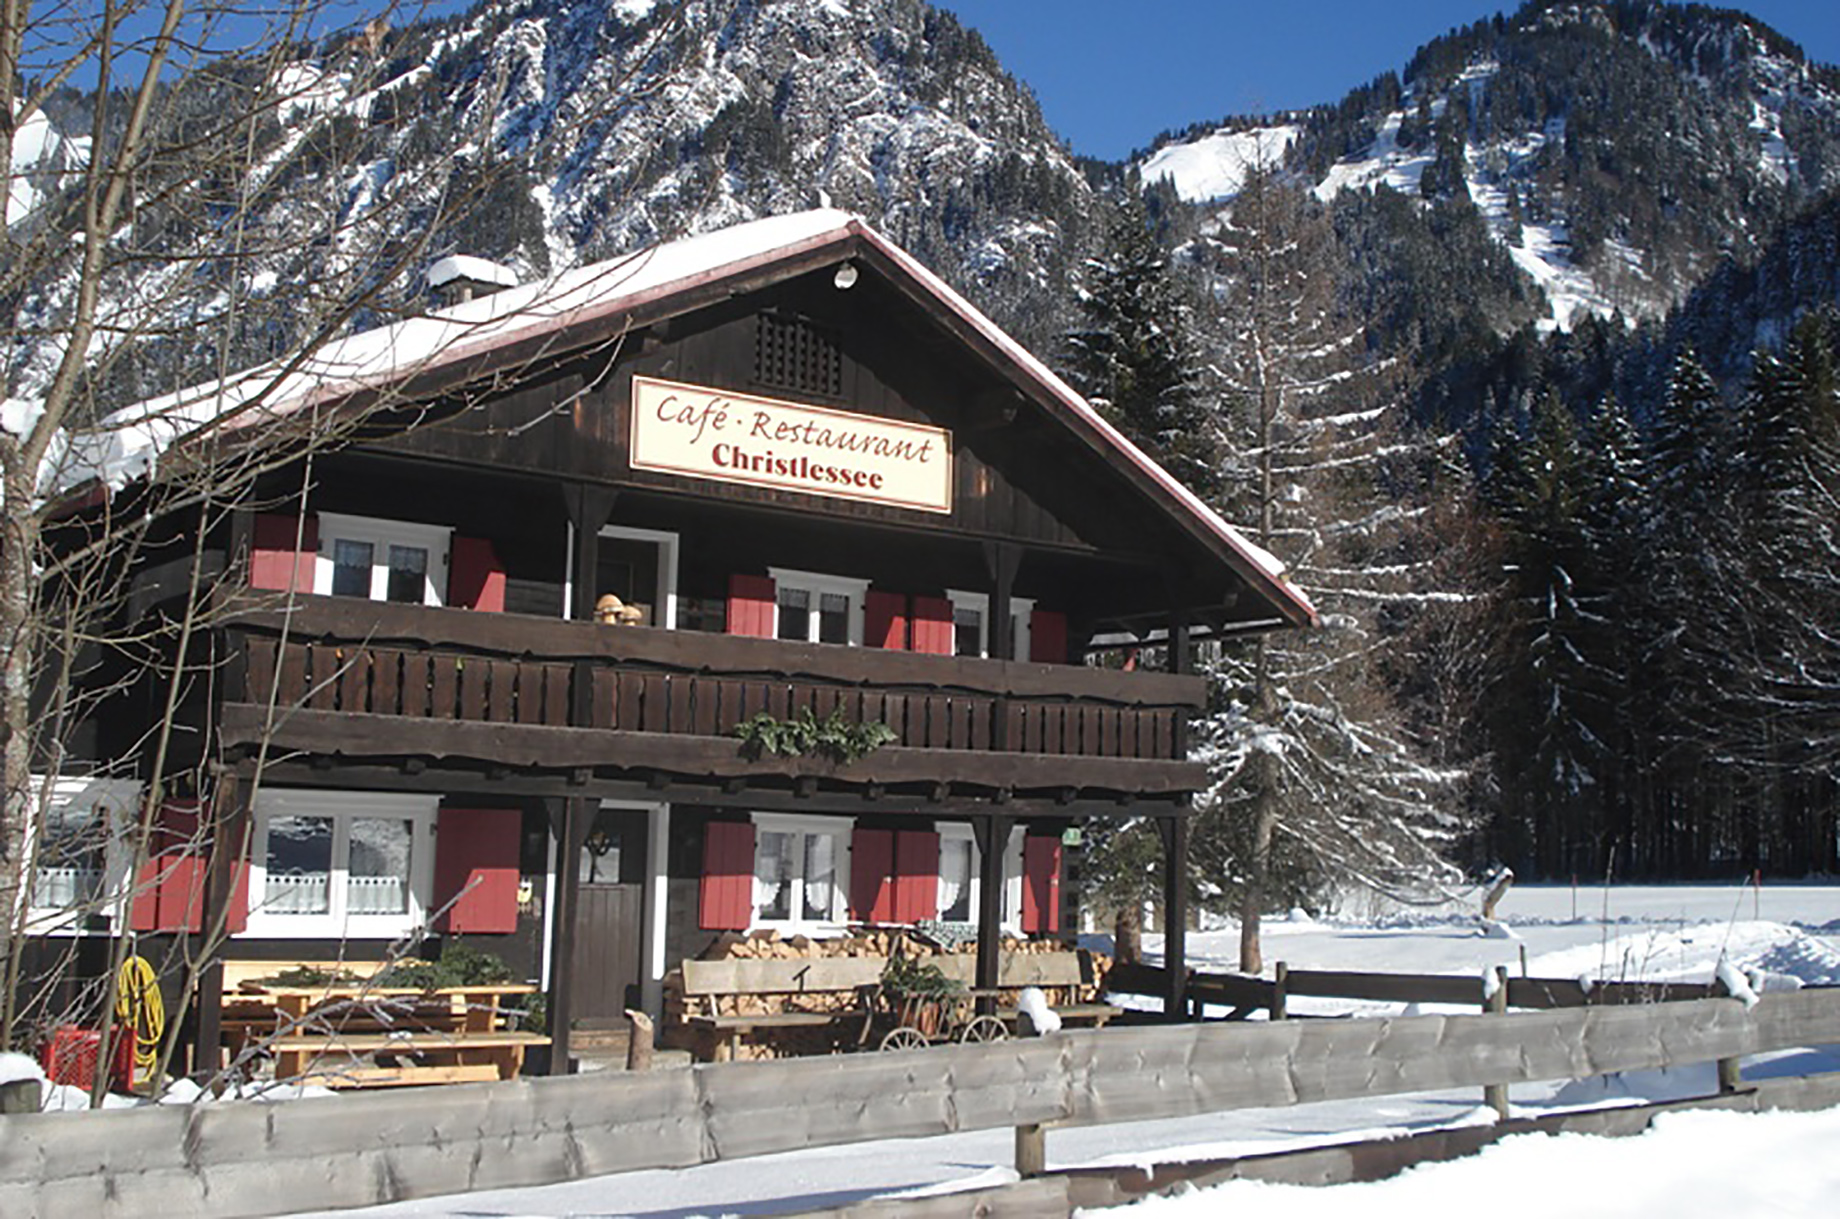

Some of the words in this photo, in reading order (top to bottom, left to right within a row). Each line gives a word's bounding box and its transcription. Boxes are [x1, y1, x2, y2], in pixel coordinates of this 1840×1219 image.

[656, 396, 731, 444] Café
[750, 411, 934, 463] Restaurant
[711, 443, 884, 490] Christlessee
